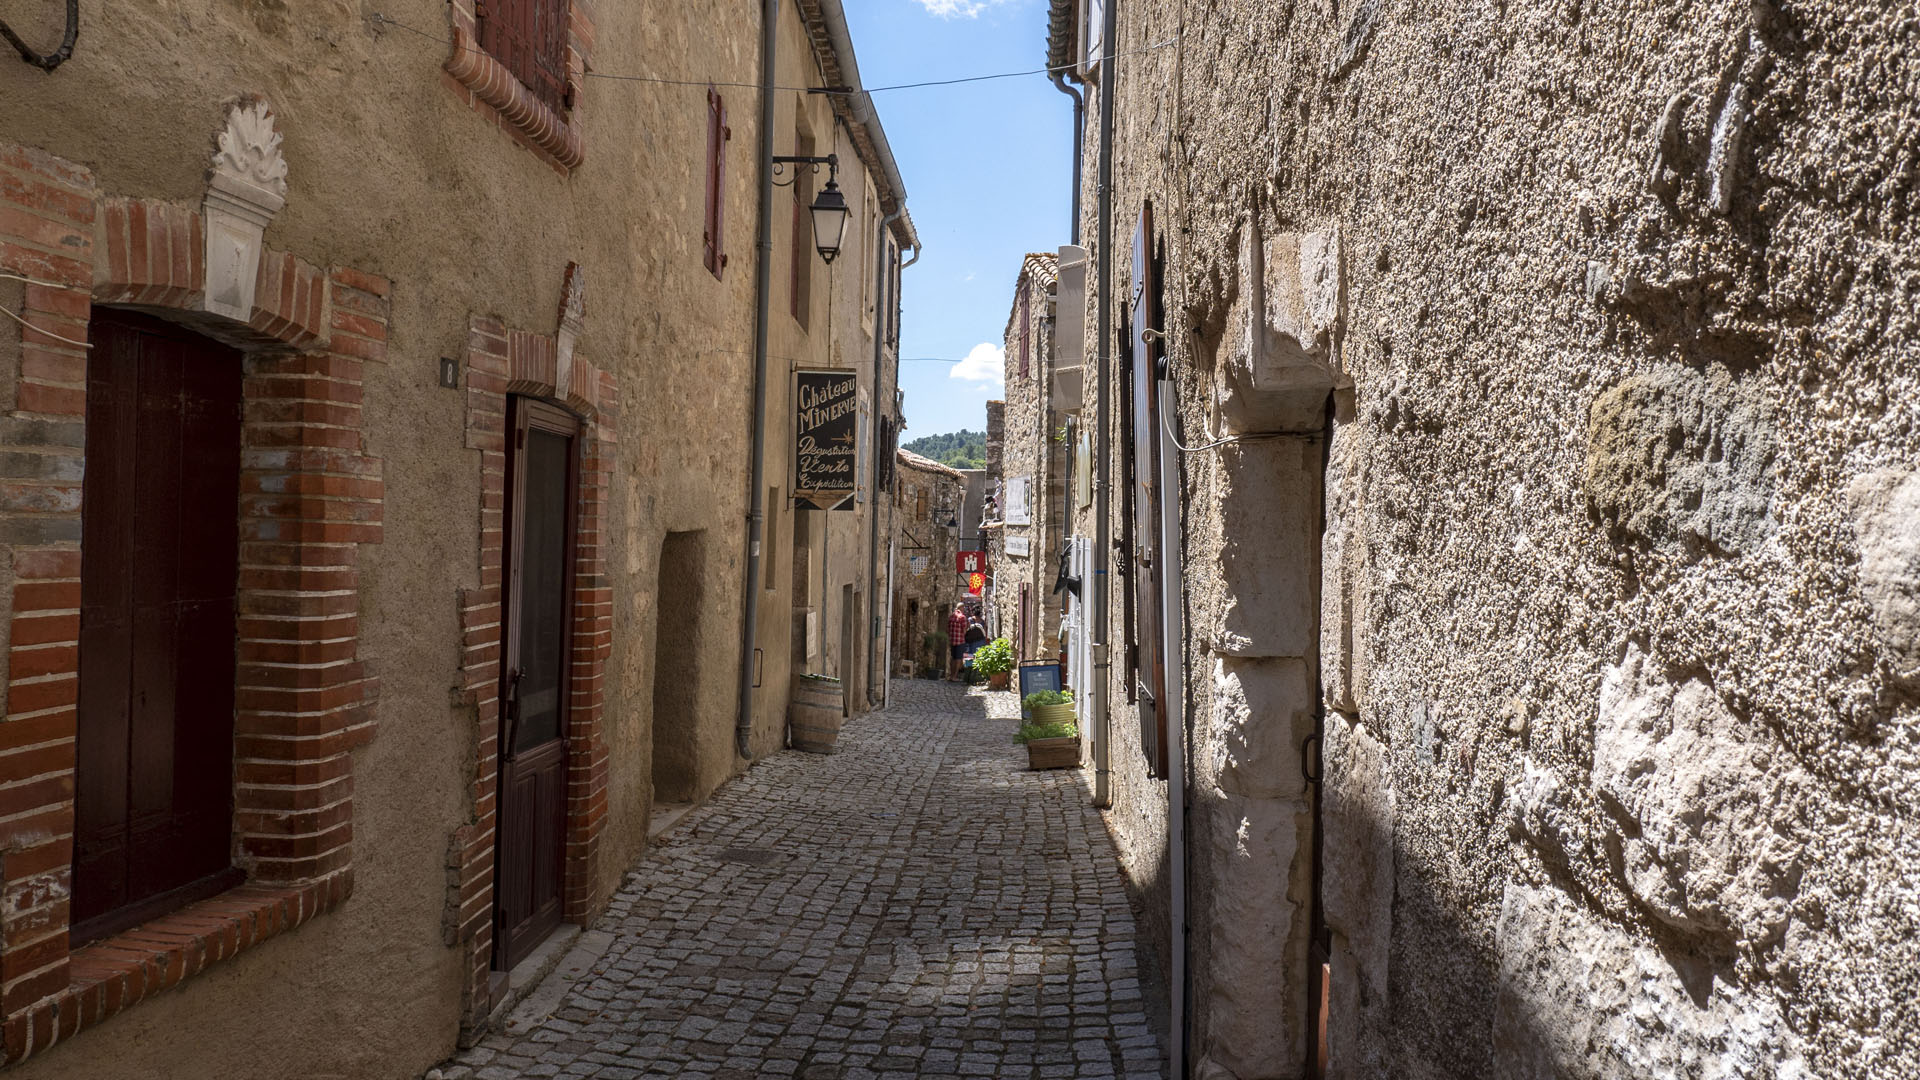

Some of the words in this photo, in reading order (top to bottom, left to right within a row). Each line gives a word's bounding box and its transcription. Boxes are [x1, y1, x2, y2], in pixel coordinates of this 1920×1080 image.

[447, 363, 453, 384] 8
[799, 378, 855, 410] Château
[799, 436, 855, 459] Dégustation
[800, 456, 849, 473] Vente
